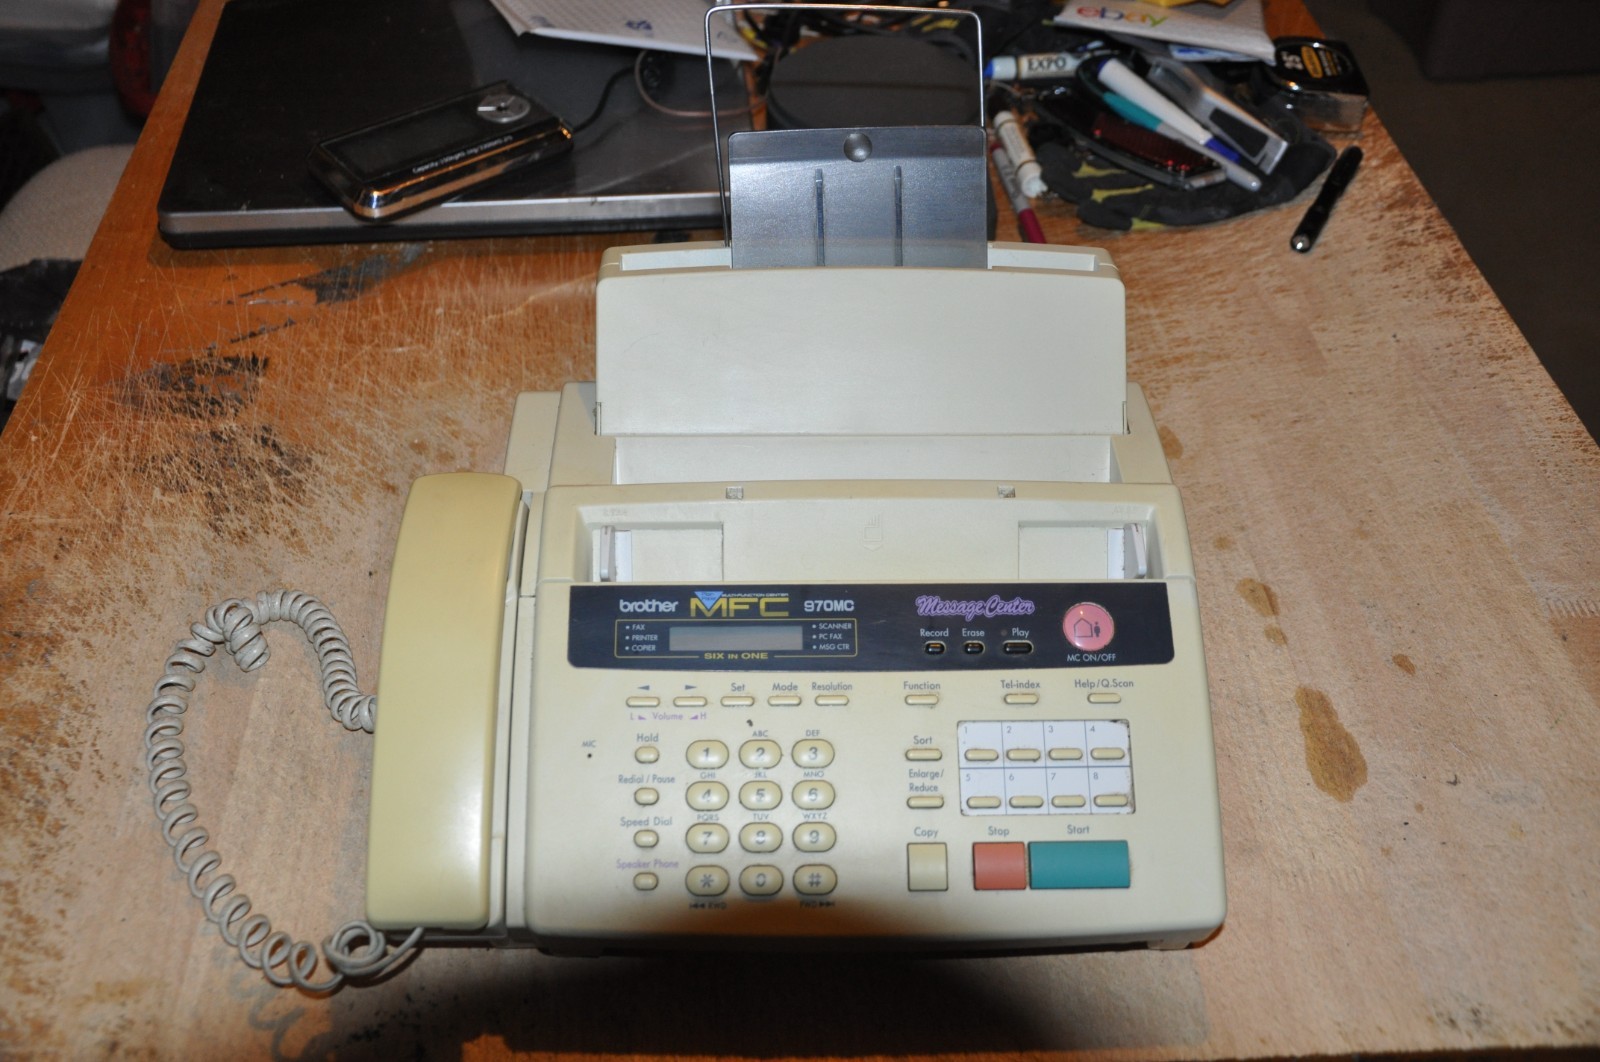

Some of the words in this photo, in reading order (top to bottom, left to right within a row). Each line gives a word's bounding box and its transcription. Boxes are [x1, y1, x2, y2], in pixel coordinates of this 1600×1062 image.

[1077, 7, 1168, 27] ebay
[1027, 56, 1067, 71] EXPO
[619, 599, 678, 612] brother
[690, 597, 789, 617] MFC
[804, 600, 854, 612] 970MC
[915, 595, 985, 621] Message
[984, 594, 1035, 618] Center
[818, 622, 852, 630] SCANNER
[920, 628, 949, 637] Record
[962, 628, 985, 637] Erase
[1012, 628, 1030, 638] Play
[1067, 654, 1081, 662] MC
[1083, 653, 1117, 663] ON/OFF
[731, 682, 745, 692] Set
[772, 683, 798, 692] Mode
[812, 681, 853, 692] Resolution
[903, 680, 941, 691] Function
[1000, 679, 1041, 690] Tel-index
[652, 711, 683, 721] Volume
[636, 733, 659, 743] Hold
[752, 729, 769, 738] ABC
[805, 729, 820, 738] DEF
[582, 740, 596, 748] MIC
[913, 735, 933, 745] Sort
[755, 747, 766, 760] 2
[808, 746, 818, 760] 3
[803, 769, 825, 778] MNO
[908, 769, 945, 780] Enlarge/
[618, 774, 645, 784] Redial
[652, 774, 676, 785] Pause
[909, 783, 939, 792] Reduce
[702, 788, 711, 803] 4
[756, 788, 766, 803] 5
[808, 787, 819, 802] 6
[753, 812, 770, 820] TUV
[803, 812, 828, 821] WXYZ
[620, 816, 650, 828] Speed
[653, 816, 673, 826] Dial
[913, 826, 939, 838] Copy
[987, 825, 1010, 837] Stop
[1067, 824, 1090, 835] Start
[703, 831, 712, 845] 7
[756, 830, 766, 845] 8
[809, 829, 819, 844] 9
[616, 858, 650, 870] Speaker
[653, 858, 679, 869] Phone
[756, 872, 766, 888] 0
